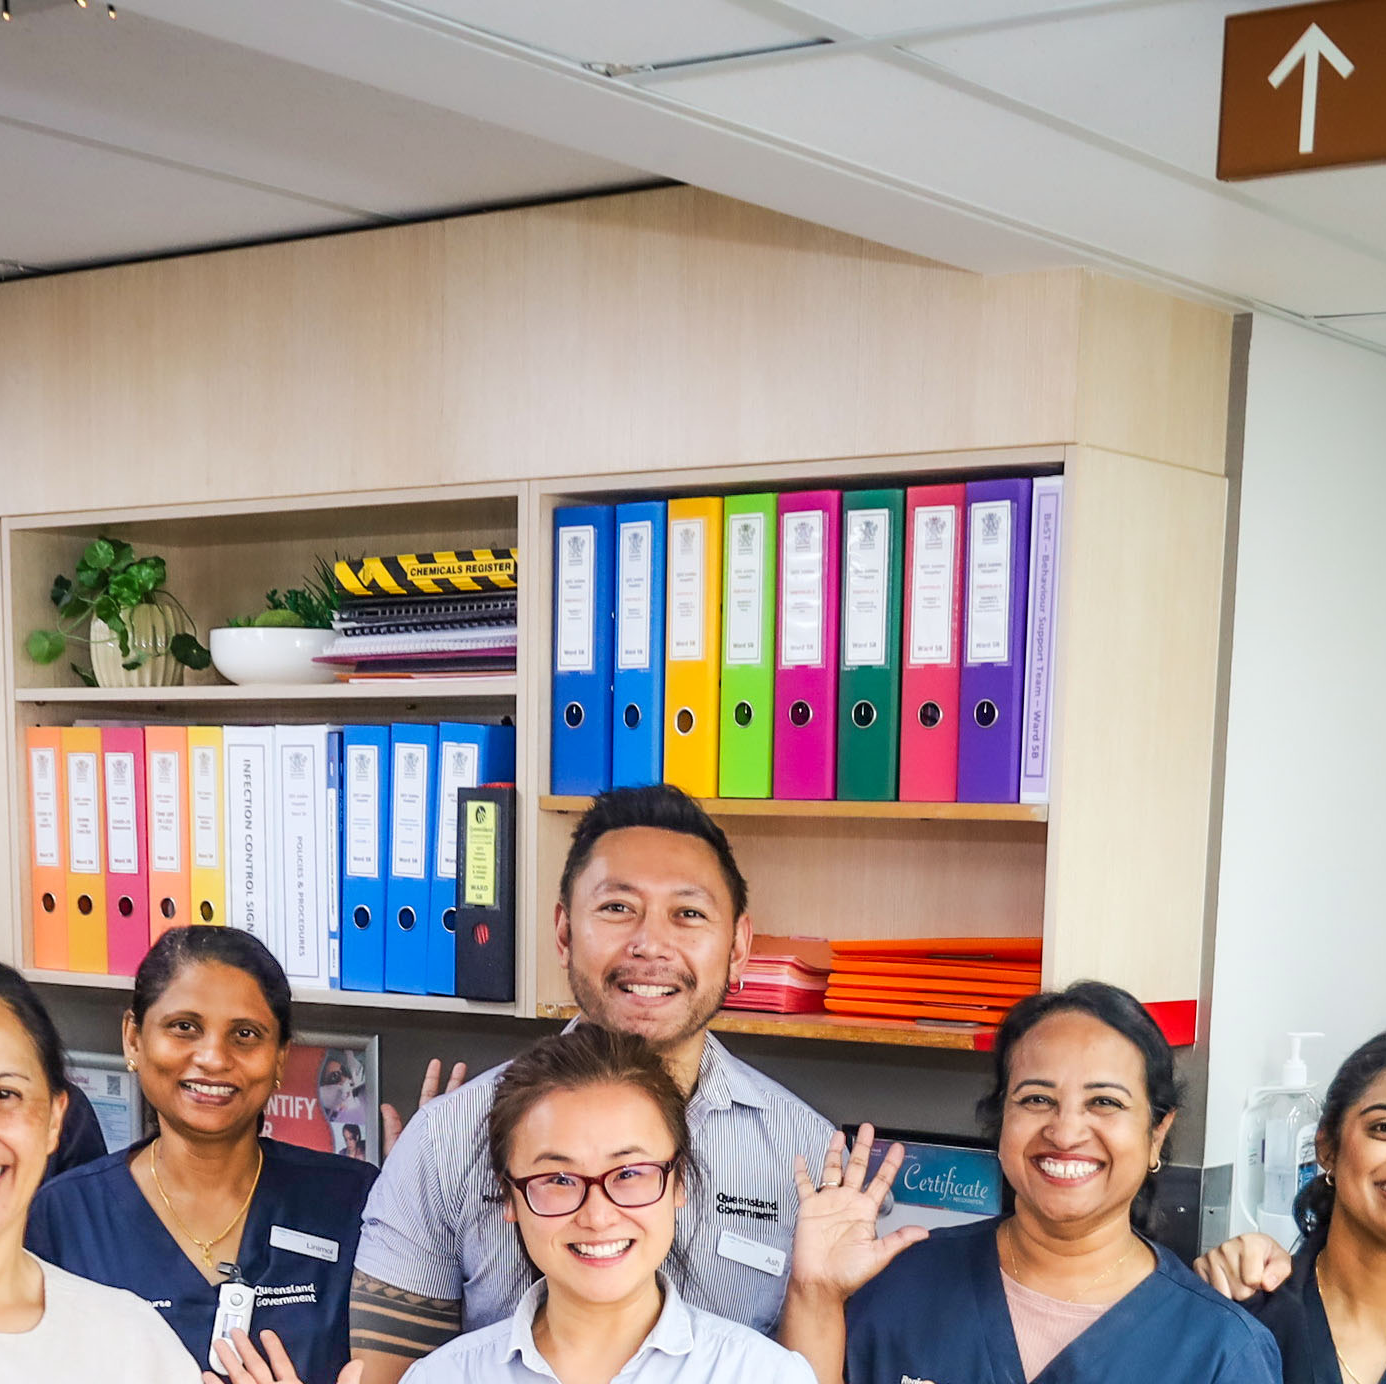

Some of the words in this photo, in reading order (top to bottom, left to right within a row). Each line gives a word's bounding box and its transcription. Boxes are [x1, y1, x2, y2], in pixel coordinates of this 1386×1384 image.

[410, 565, 463, 577] CHEMICALS
[465, 562, 512, 575] REGISTER
[1038, 553, 1051, 614] Behaviour
[1034, 615, 1048, 662] Support
[1034, 665, 1045, 698] Team
[1031, 709, 1043, 743] Ward
[242, 759, 253, 829] INFECTION
[244, 834, 254, 897] CONTROL
[297, 891, 305, 957] PROCEDURES
[904, 1163, 989, 1201] Certificate
[716, 1192, 778, 1211] Queensland
[716, 1204, 779, 1222] Government
[765, 1256, 780, 1268] Ash
[254, 1283, 315, 1297] Queensland
[255, 1294, 317, 1308] Government
